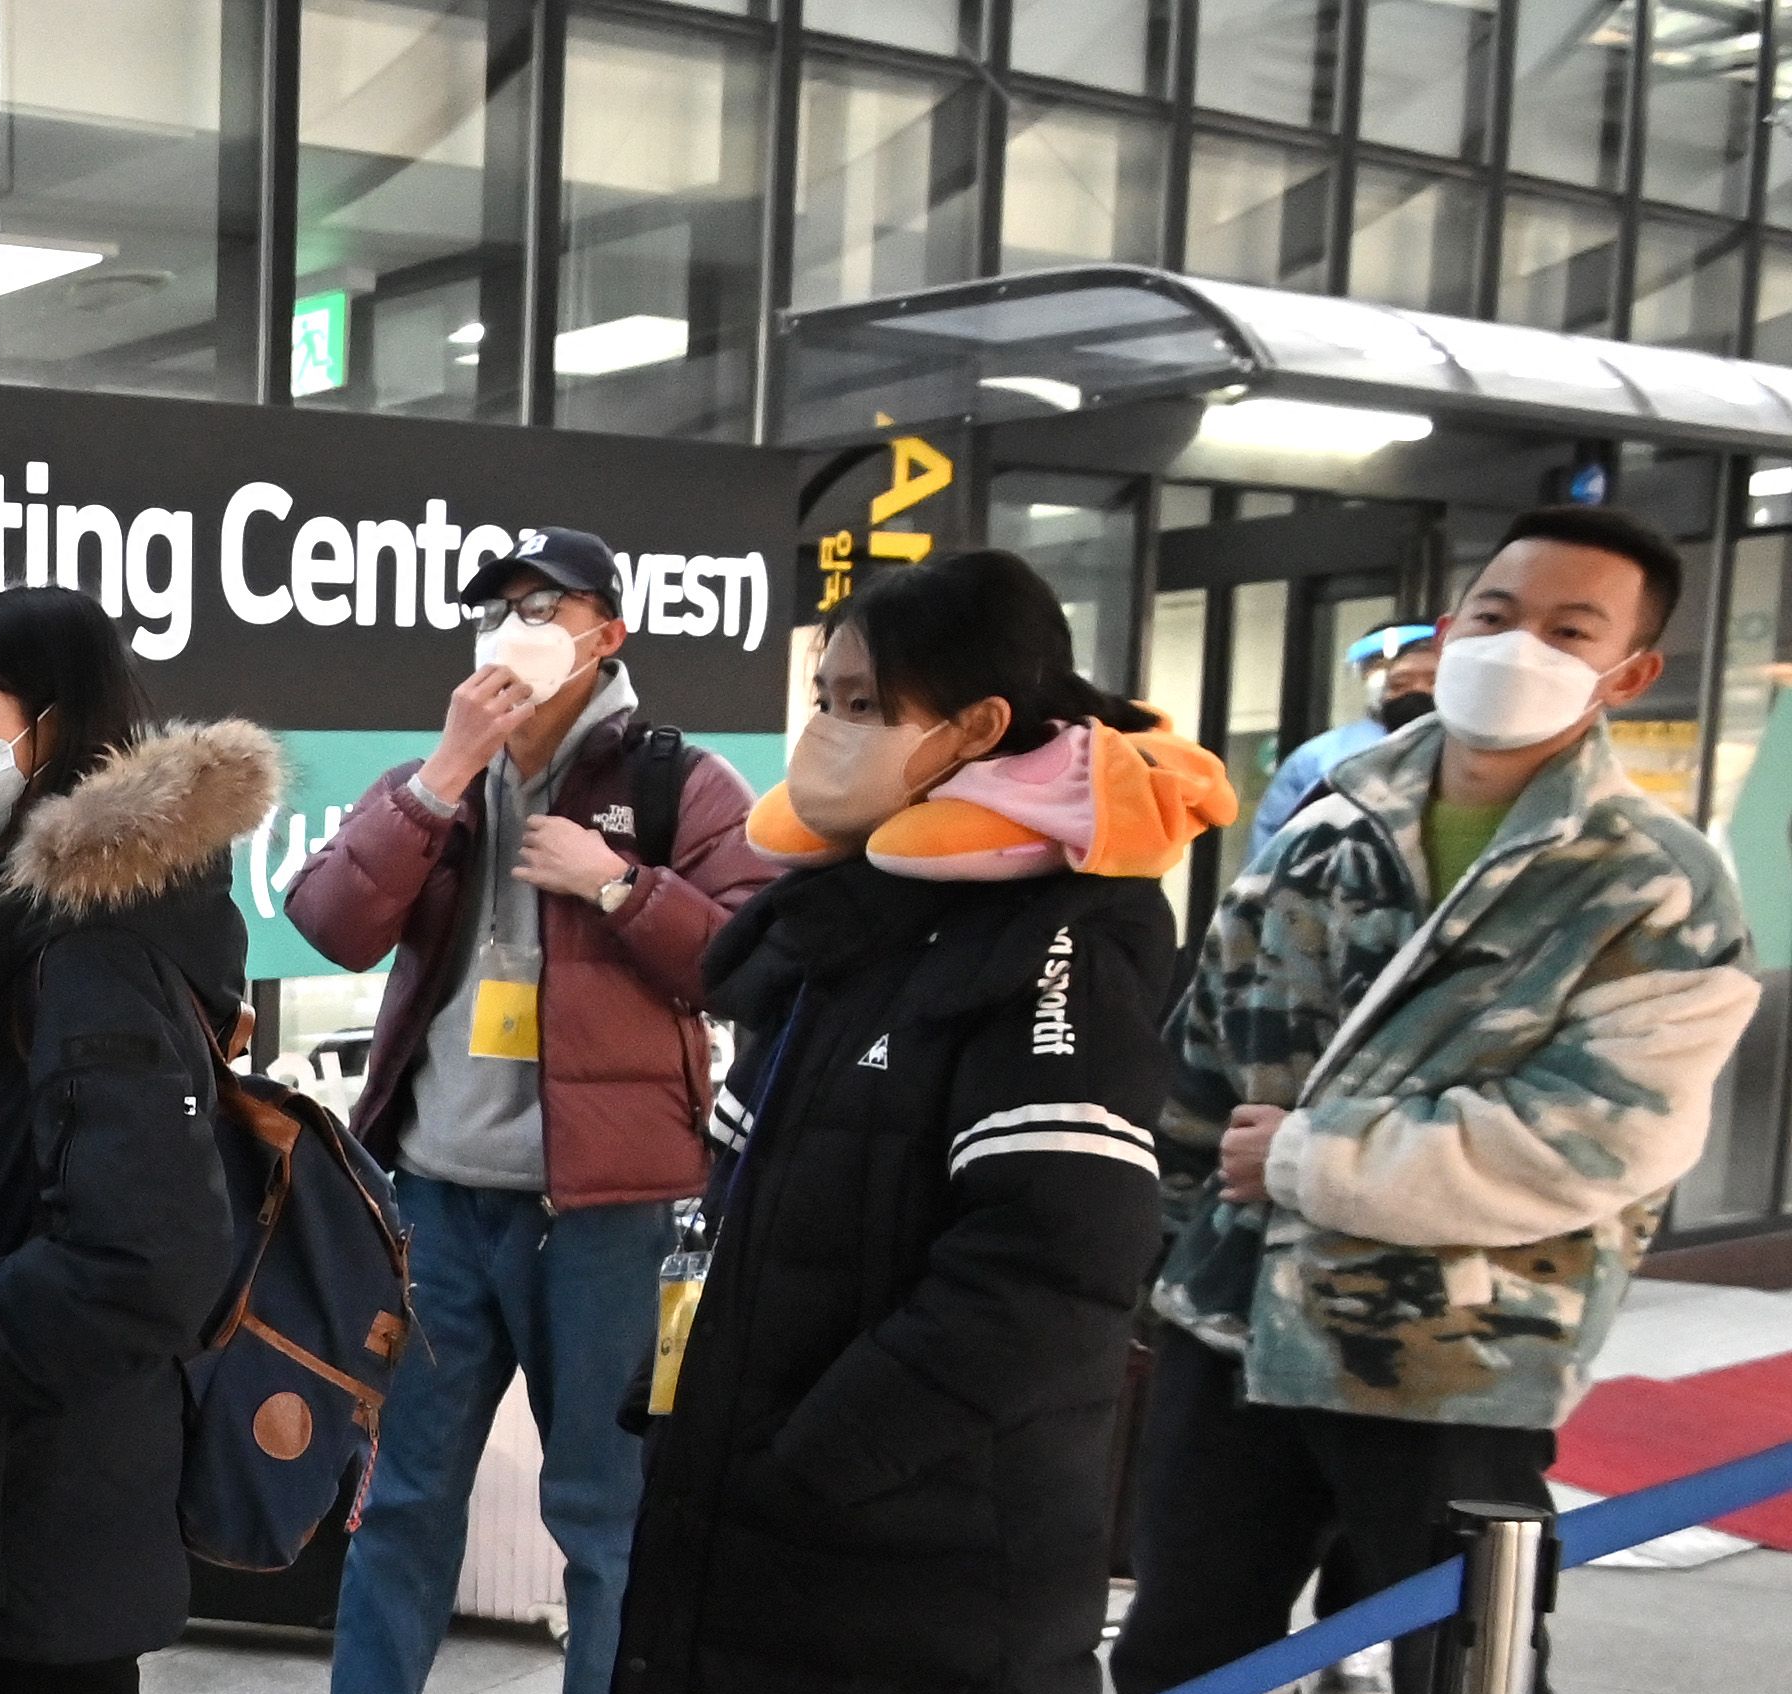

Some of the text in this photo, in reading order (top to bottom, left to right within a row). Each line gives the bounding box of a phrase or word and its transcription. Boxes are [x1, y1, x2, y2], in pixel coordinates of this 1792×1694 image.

[220, 481, 538, 630] Cente
[616, 551, 769, 652] WEST)
[1031, 958, 1076, 1056] sportif
